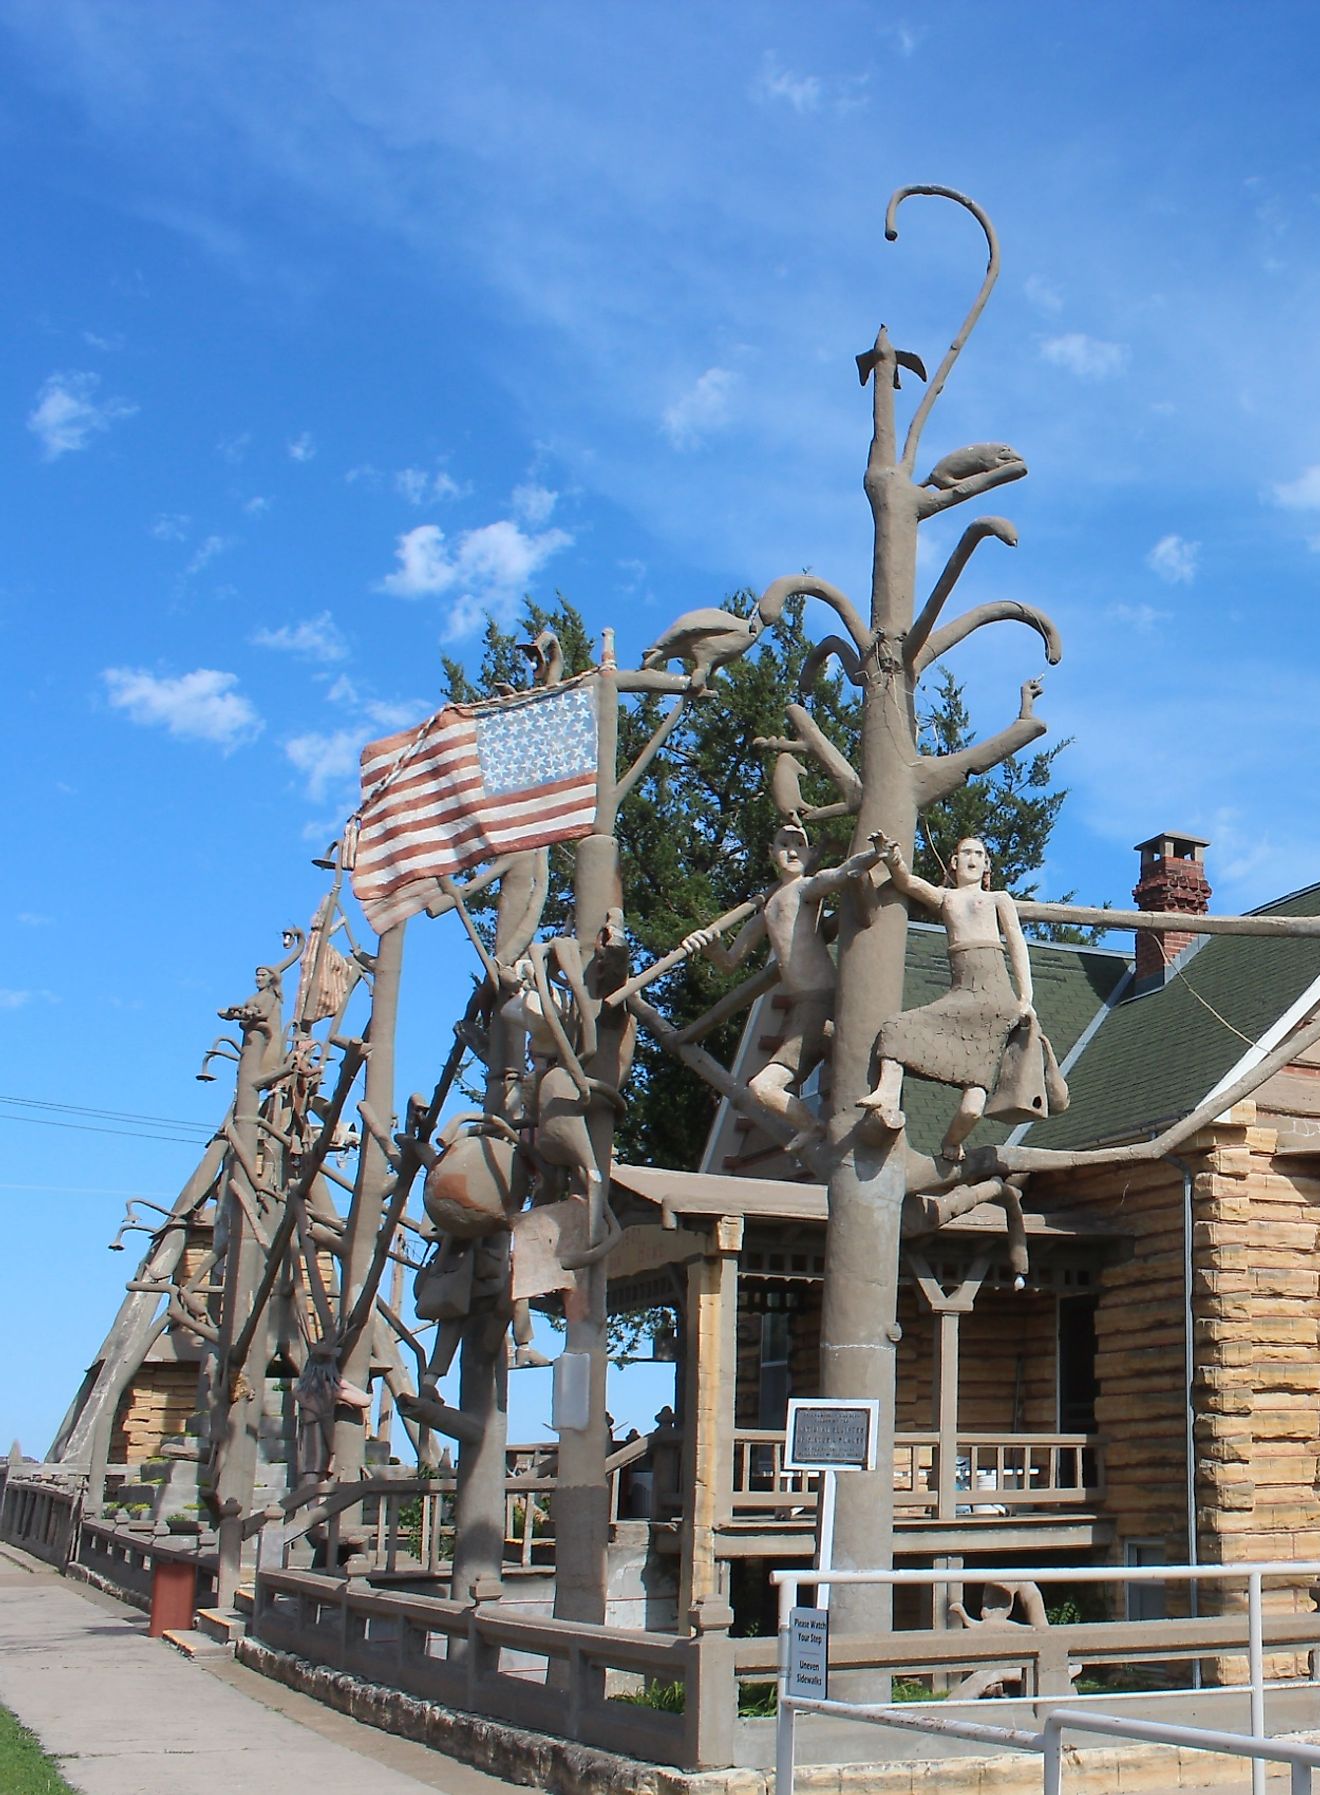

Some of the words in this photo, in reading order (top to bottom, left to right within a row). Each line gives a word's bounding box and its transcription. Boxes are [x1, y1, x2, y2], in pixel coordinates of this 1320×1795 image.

[794, 1618, 810, 1630] Please
[810, 1620, 826, 1630] Watch
[798, 1632, 810, 1642] Your
[810, 1633, 822, 1646] Step
[799, 1660, 820, 1672] Uneven
[796, 1673, 822, 1686] Sidewalks
